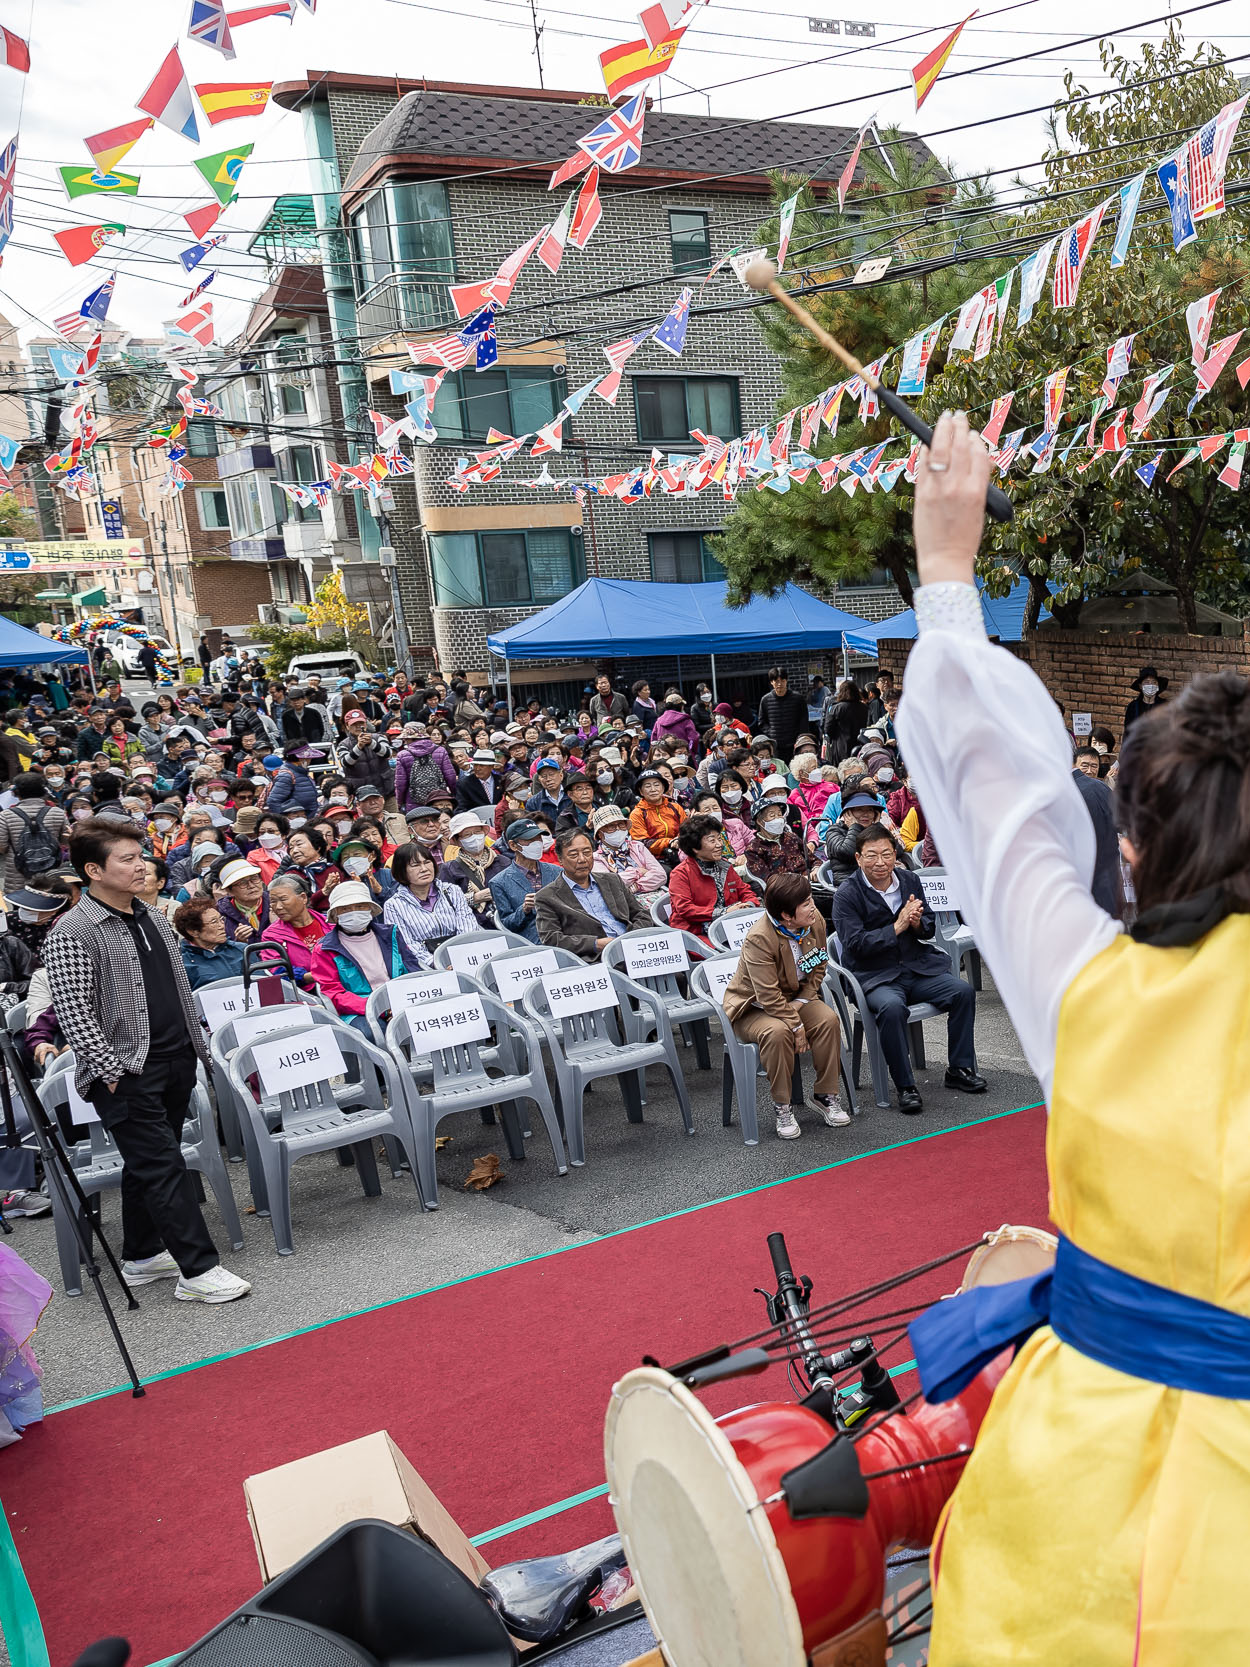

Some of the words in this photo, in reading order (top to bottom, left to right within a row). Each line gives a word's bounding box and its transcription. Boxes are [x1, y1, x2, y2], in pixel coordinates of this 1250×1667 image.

[637, 939, 670, 954] 구의회
[631, 953, 682, 969] 의회운영위원장
[510, 965, 544, 982] 구의원
[549, 977, 609, 1001] 당협위원장
[414, 1007, 480, 1033] 지역위원장
[279, 1046, 322, 1070] 시의원
